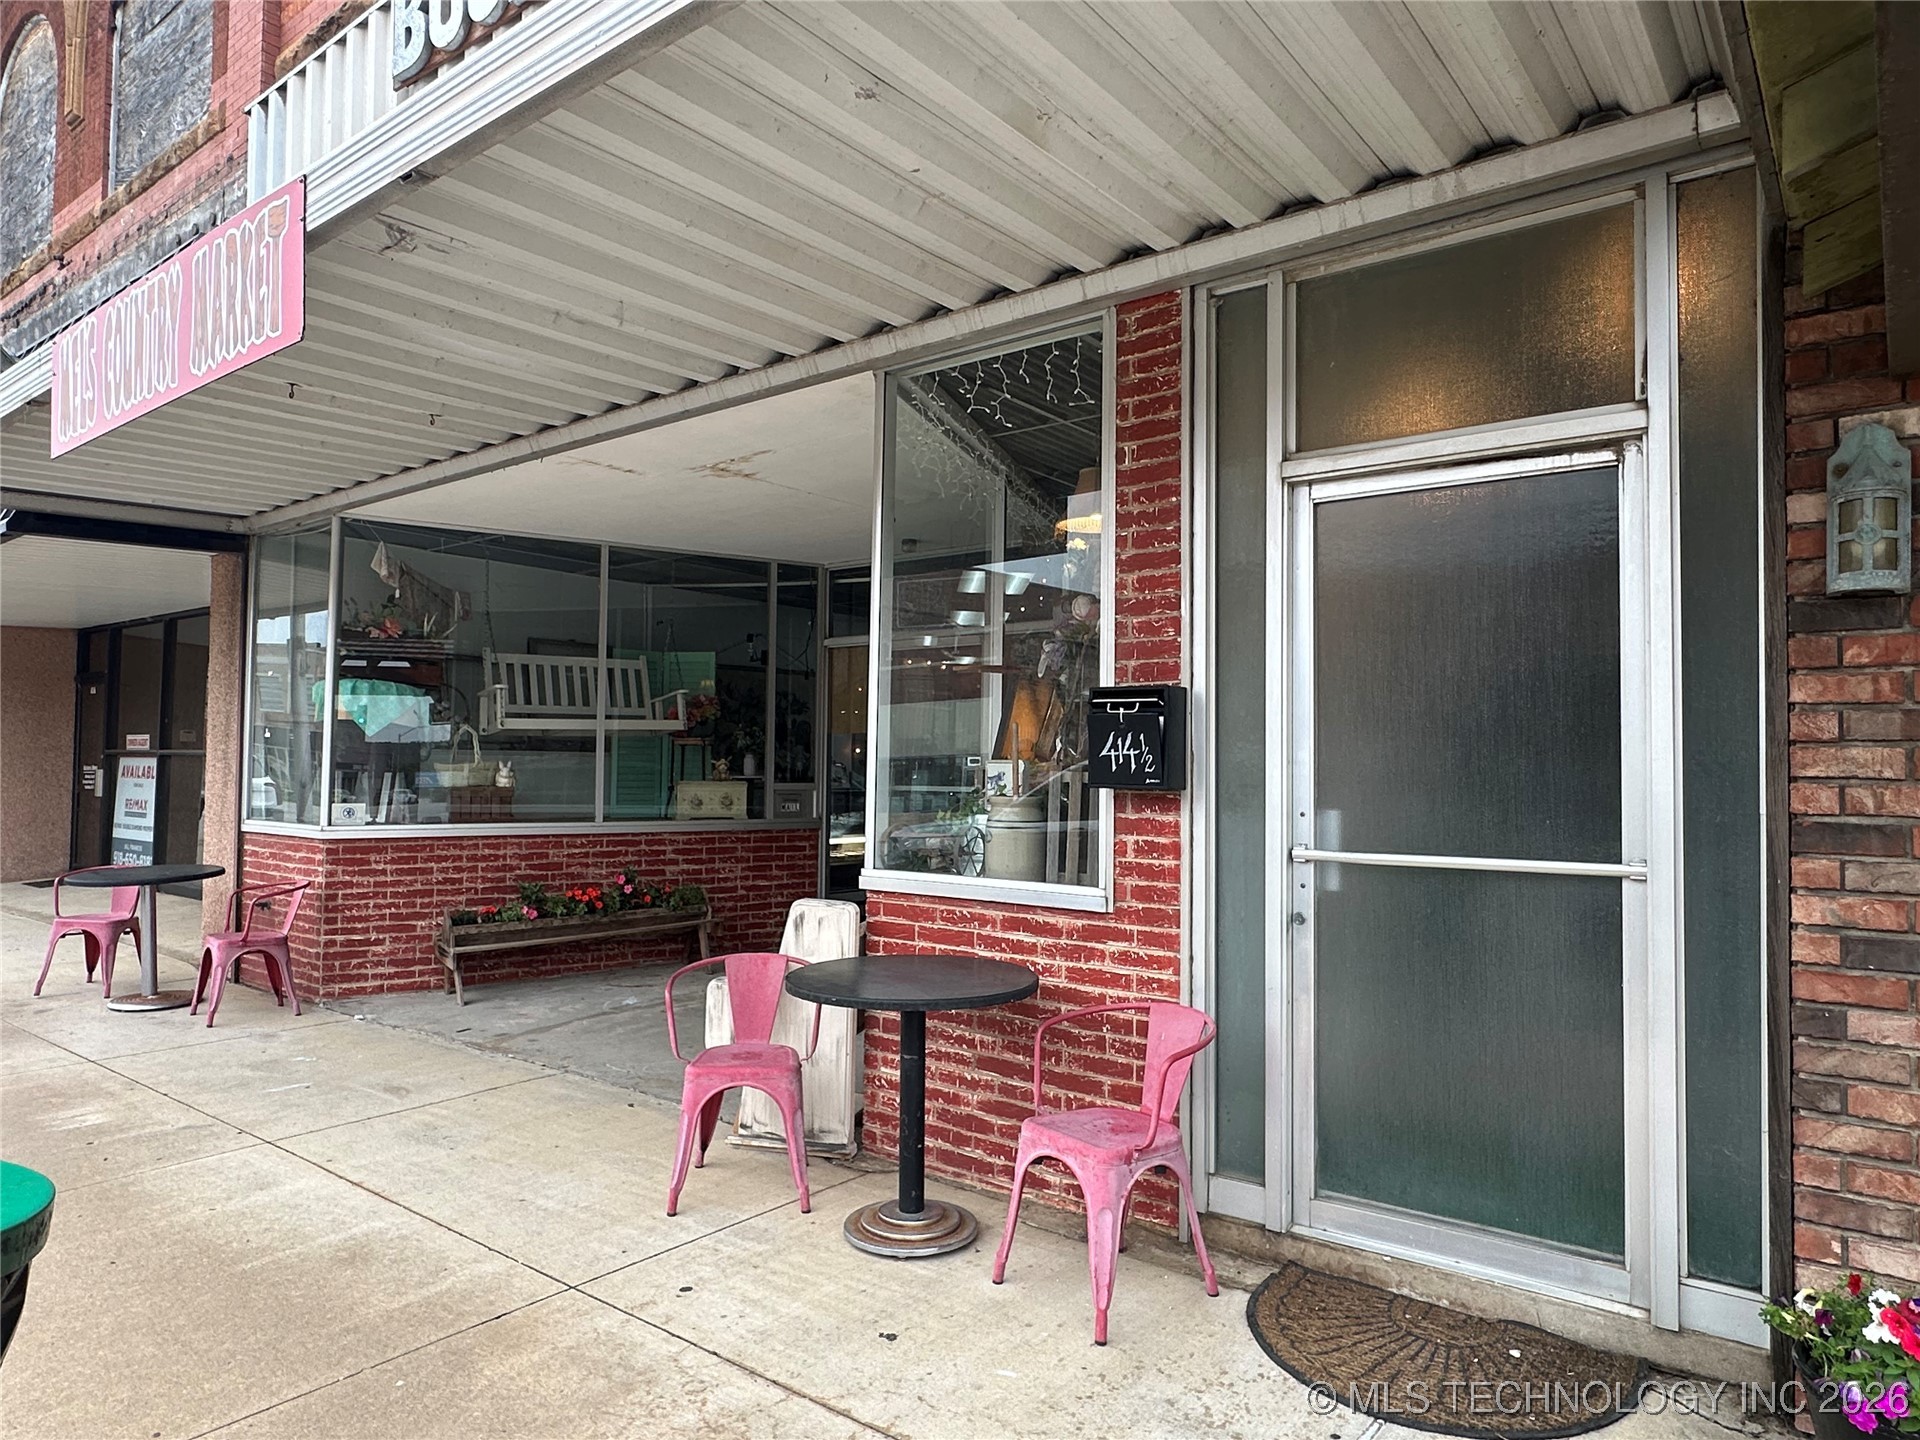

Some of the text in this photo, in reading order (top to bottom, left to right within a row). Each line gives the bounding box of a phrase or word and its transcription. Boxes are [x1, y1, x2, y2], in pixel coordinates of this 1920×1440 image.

[103, 264, 182, 419] COUNTRY
[189, 195, 290, 376] MARKET
[125, 798, 148, 811] RE/MAX
